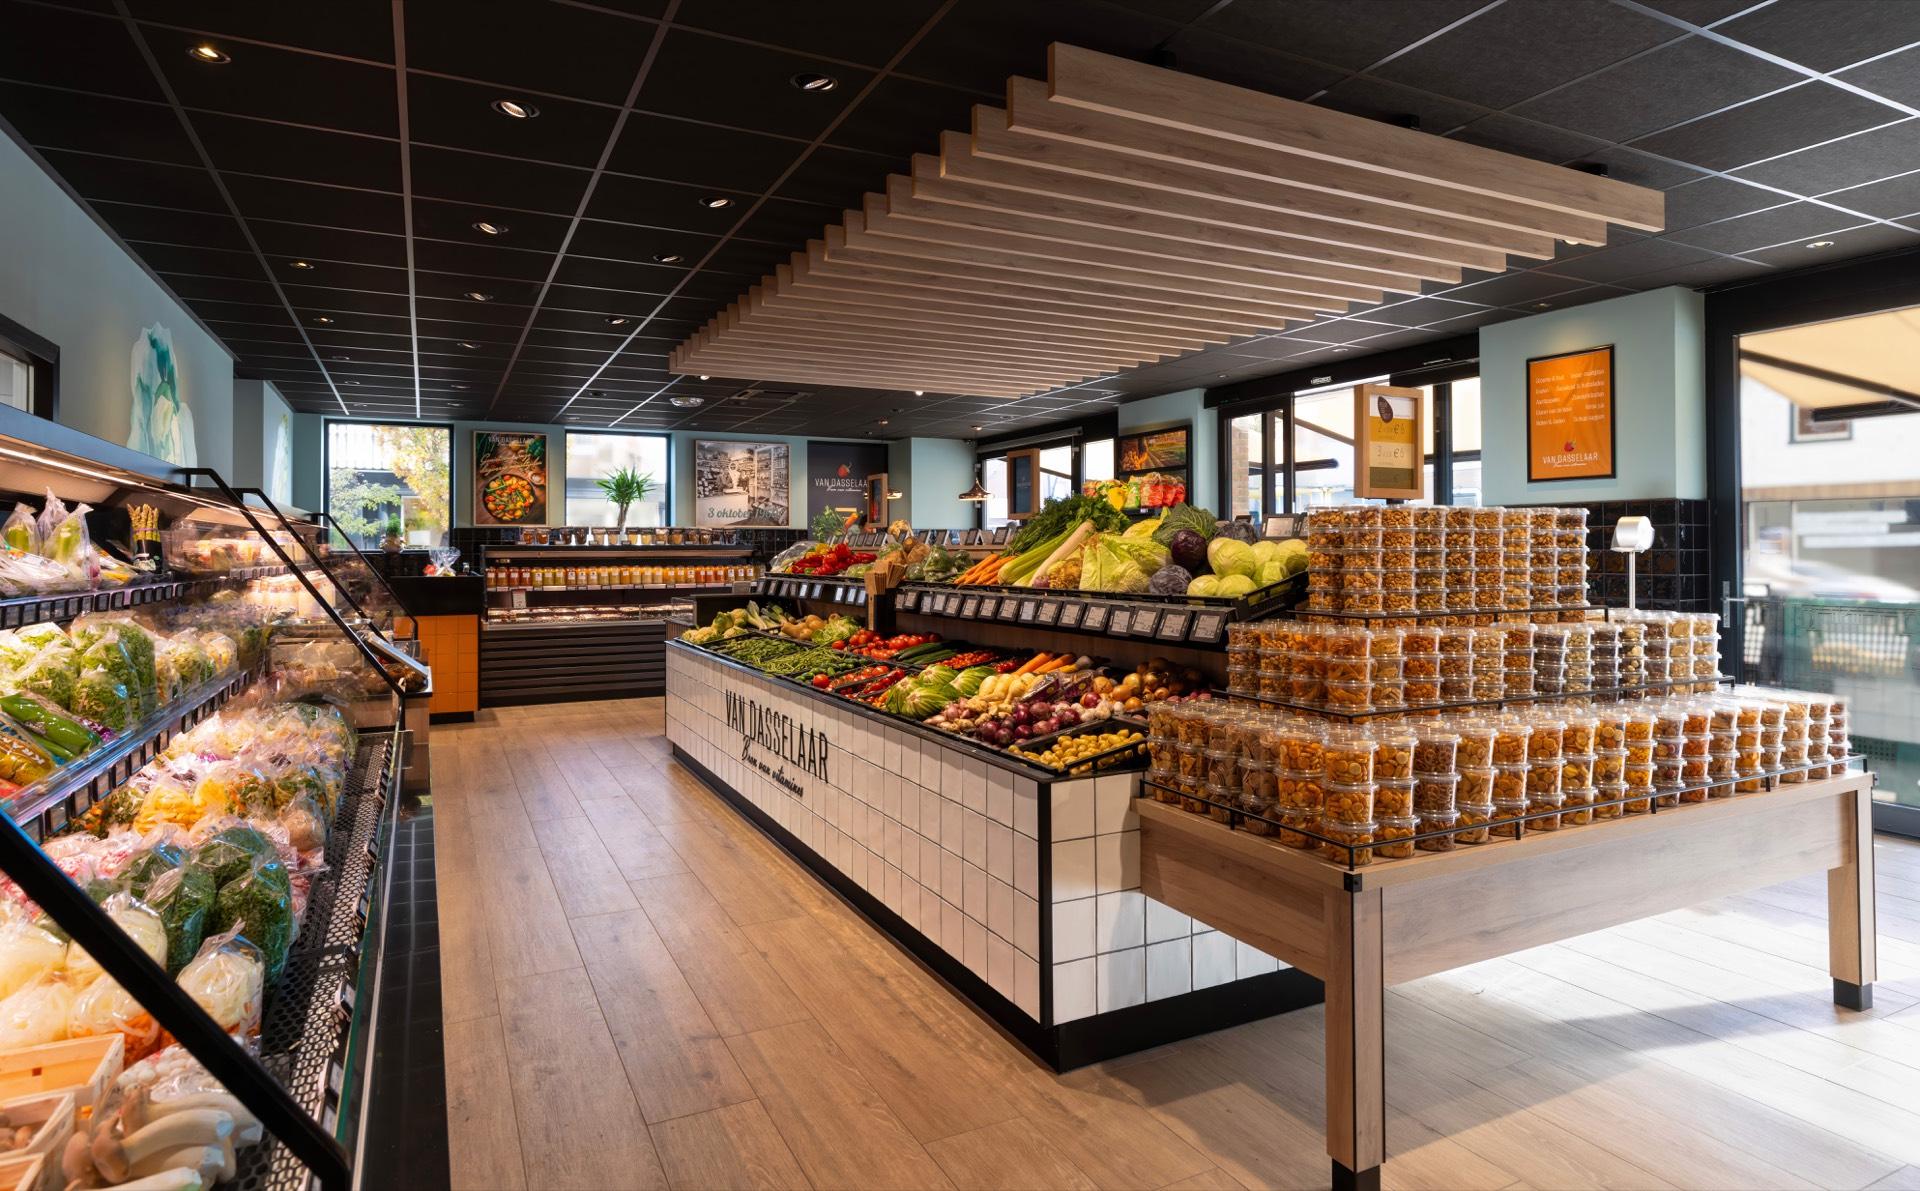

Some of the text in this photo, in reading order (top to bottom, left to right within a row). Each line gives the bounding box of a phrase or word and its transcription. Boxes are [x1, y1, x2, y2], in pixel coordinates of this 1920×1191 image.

[1542, 451, 1599, 464] VAN DASSELAAR
[815, 478, 868, 488] VAN DASSELAA
[707, 507, 715, 519] 3
[716, 507, 754, 519] oktober
[725, 688, 829, 784] VAN DASSELAAR
[758, 761, 771, 777] van
